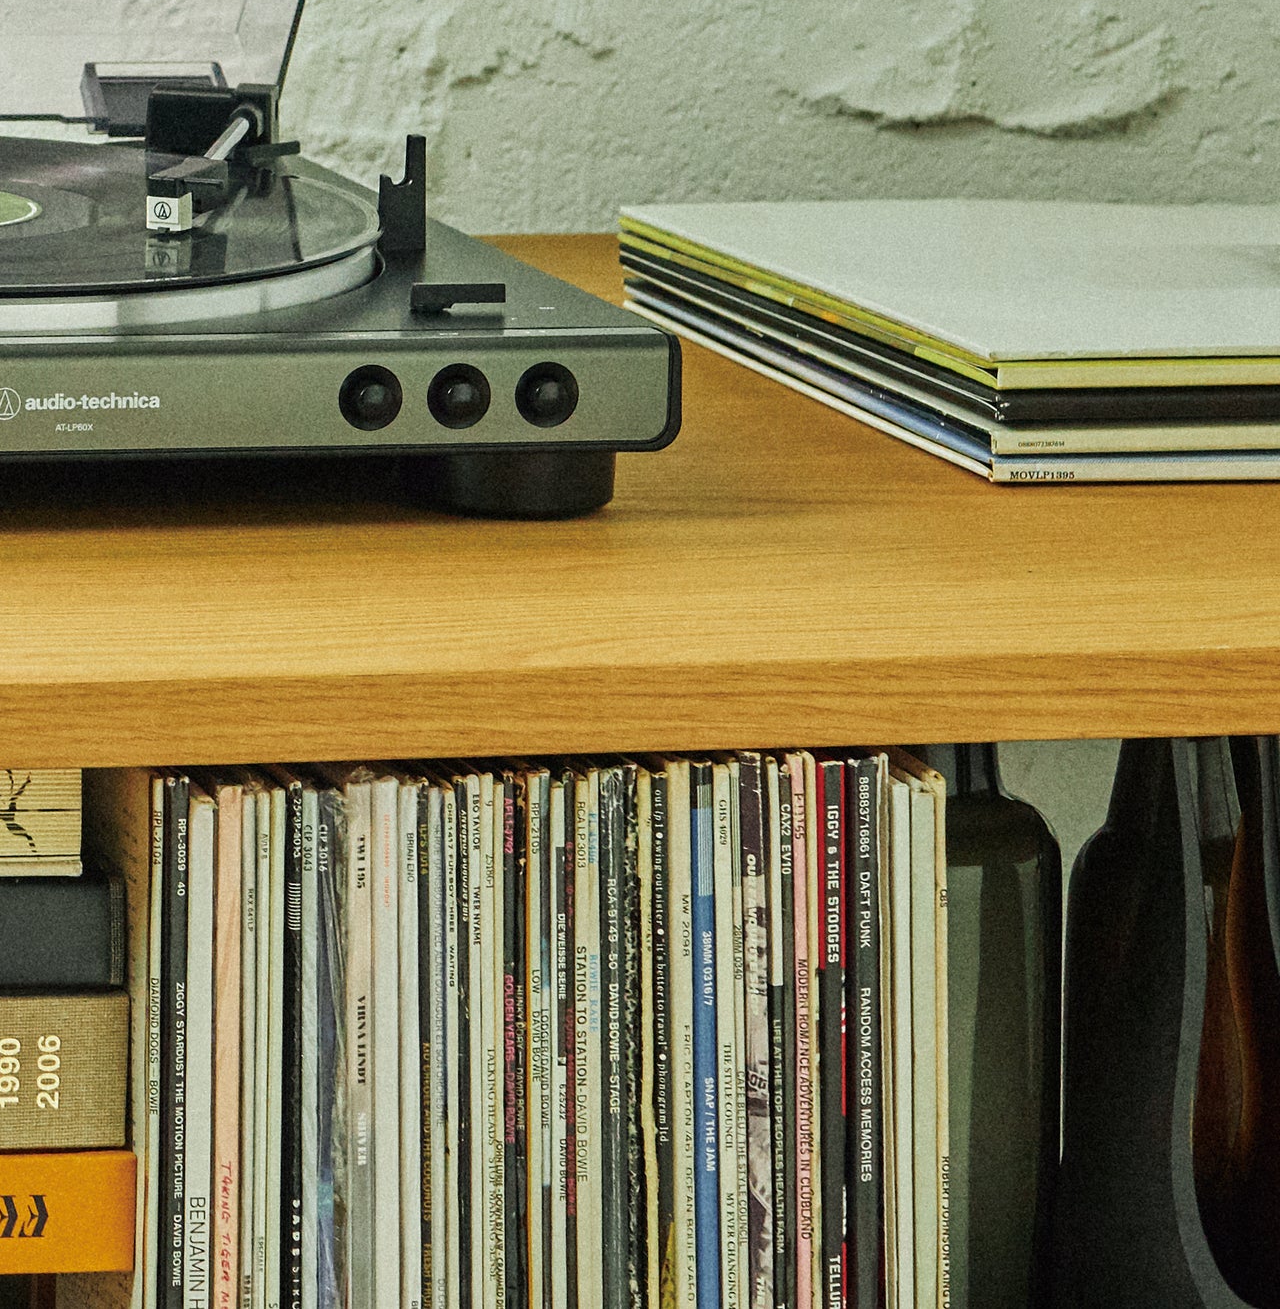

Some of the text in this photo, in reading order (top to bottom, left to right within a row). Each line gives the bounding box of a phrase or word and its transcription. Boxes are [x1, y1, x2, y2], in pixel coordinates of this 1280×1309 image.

[25, 392, 160, 411] audio-technica
[55, 423, 93, 432] AT-LP60X
[1010, 470, 1076, 480] MOVLP1395
[653, 810, 663, 821] lp
[655, 789, 663, 807] out
[719, 799, 727, 845] GHS 4029
[827, 805, 839, 839] IGGY
[153, 811, 161, 865] RPL-2104
[303, 825, 312, 872] CLP 3043
[318, 824, 328, 872] CLP 3016
[531, 802, 540, 854] RPL-2105
[577, 801, 586, 868] RCA LP 3013
[653, 840, 663, 871] swing
[781, 804, 791, 875] CAX2 EV10
[357, 834, 365, 889] TWI 195
[406, 833, 415, 882] BRIAN ENO
[472, 794, 481, 945] EBO TAYLOR TWER NYAME
[655, 873, 663, 891] out
[827, 861, 839, 889] THE
[655, 894, 664, 925] sister
[939, 888, 948, 908] CBS
[558, 913, 566, 1000] DIE WEISSE SERIE
[734, 924, 742, 980] 28MM 0340
[828, 896, 839, 963] STOOGES
[577, 946, 586, 1003] STATION
[589, 954, 598, 1032] BOWIE RARE
[656, 964, 665, 997] better
[703, 931, 713, 1006] 38MM 0316/7
[859, 776, 872, 1182] 88883716861 DAFT PUNK RANDOM ACCESS MEMORIES
[531, 969, 541, 1082] LOW DAVID BOWIE
[577, 1008, 586, 1025] TO
[657, 1000, 665, 1010] to
[36, 1035, 61, 1109] 2006
[149, 978, 159, 1115] DIAMOND DOGS BOWIE
[487, 1047, 495, 1101] TALKING
[515, 985, 525, 1131] HUNKY DORY DAVID BOWIE
[541, 1009, 549, 1129] LODGER/DAVID BOWIE
[357, 995, 367, 1166] VIRNA LINDT SHIVER
[657, 1064, 667, 1124] phonogram
[797, 958, 811, 1239] MODERN ROMANCE/ADVENTURES IN CLUBLAND
[173, 982, 184, 1287] ZIGGY STARDUST THE MOTION PICTURE DAVID BOWIE
[488, 1105, 496, 1145] HEADS
[659, 1127, 668, 1145] ltd.
[705, 1077, 715, 1171] SNAP THE JAM
[738, 1141, 746, 1161] THE
[773, 1019, 785, 1253] LIFE AT THE TOP PEOPLES HEALTH FARM
[559, 1139, 567, 1201] DAVID BOWIE
[577, 1140, 588, 1182] BOWIE
[724, 1043, 736, 1299] THE STYLE COUNCIL MY EVER CHANGING
[738, 1163, 747, 1196] STYLE
[189, 1197, 206, 1291] BENJAMIN
[221, 1161, 232, 1282] TAKING TIGER
[495, 1140, 504, 1297] JOHN LURIE DOWN BY LAW CRAMMED
[739, 1200, 748, 1246] COUNCIL
[942, 1155, 951, 1297] ROBERT JOHNSON KING
